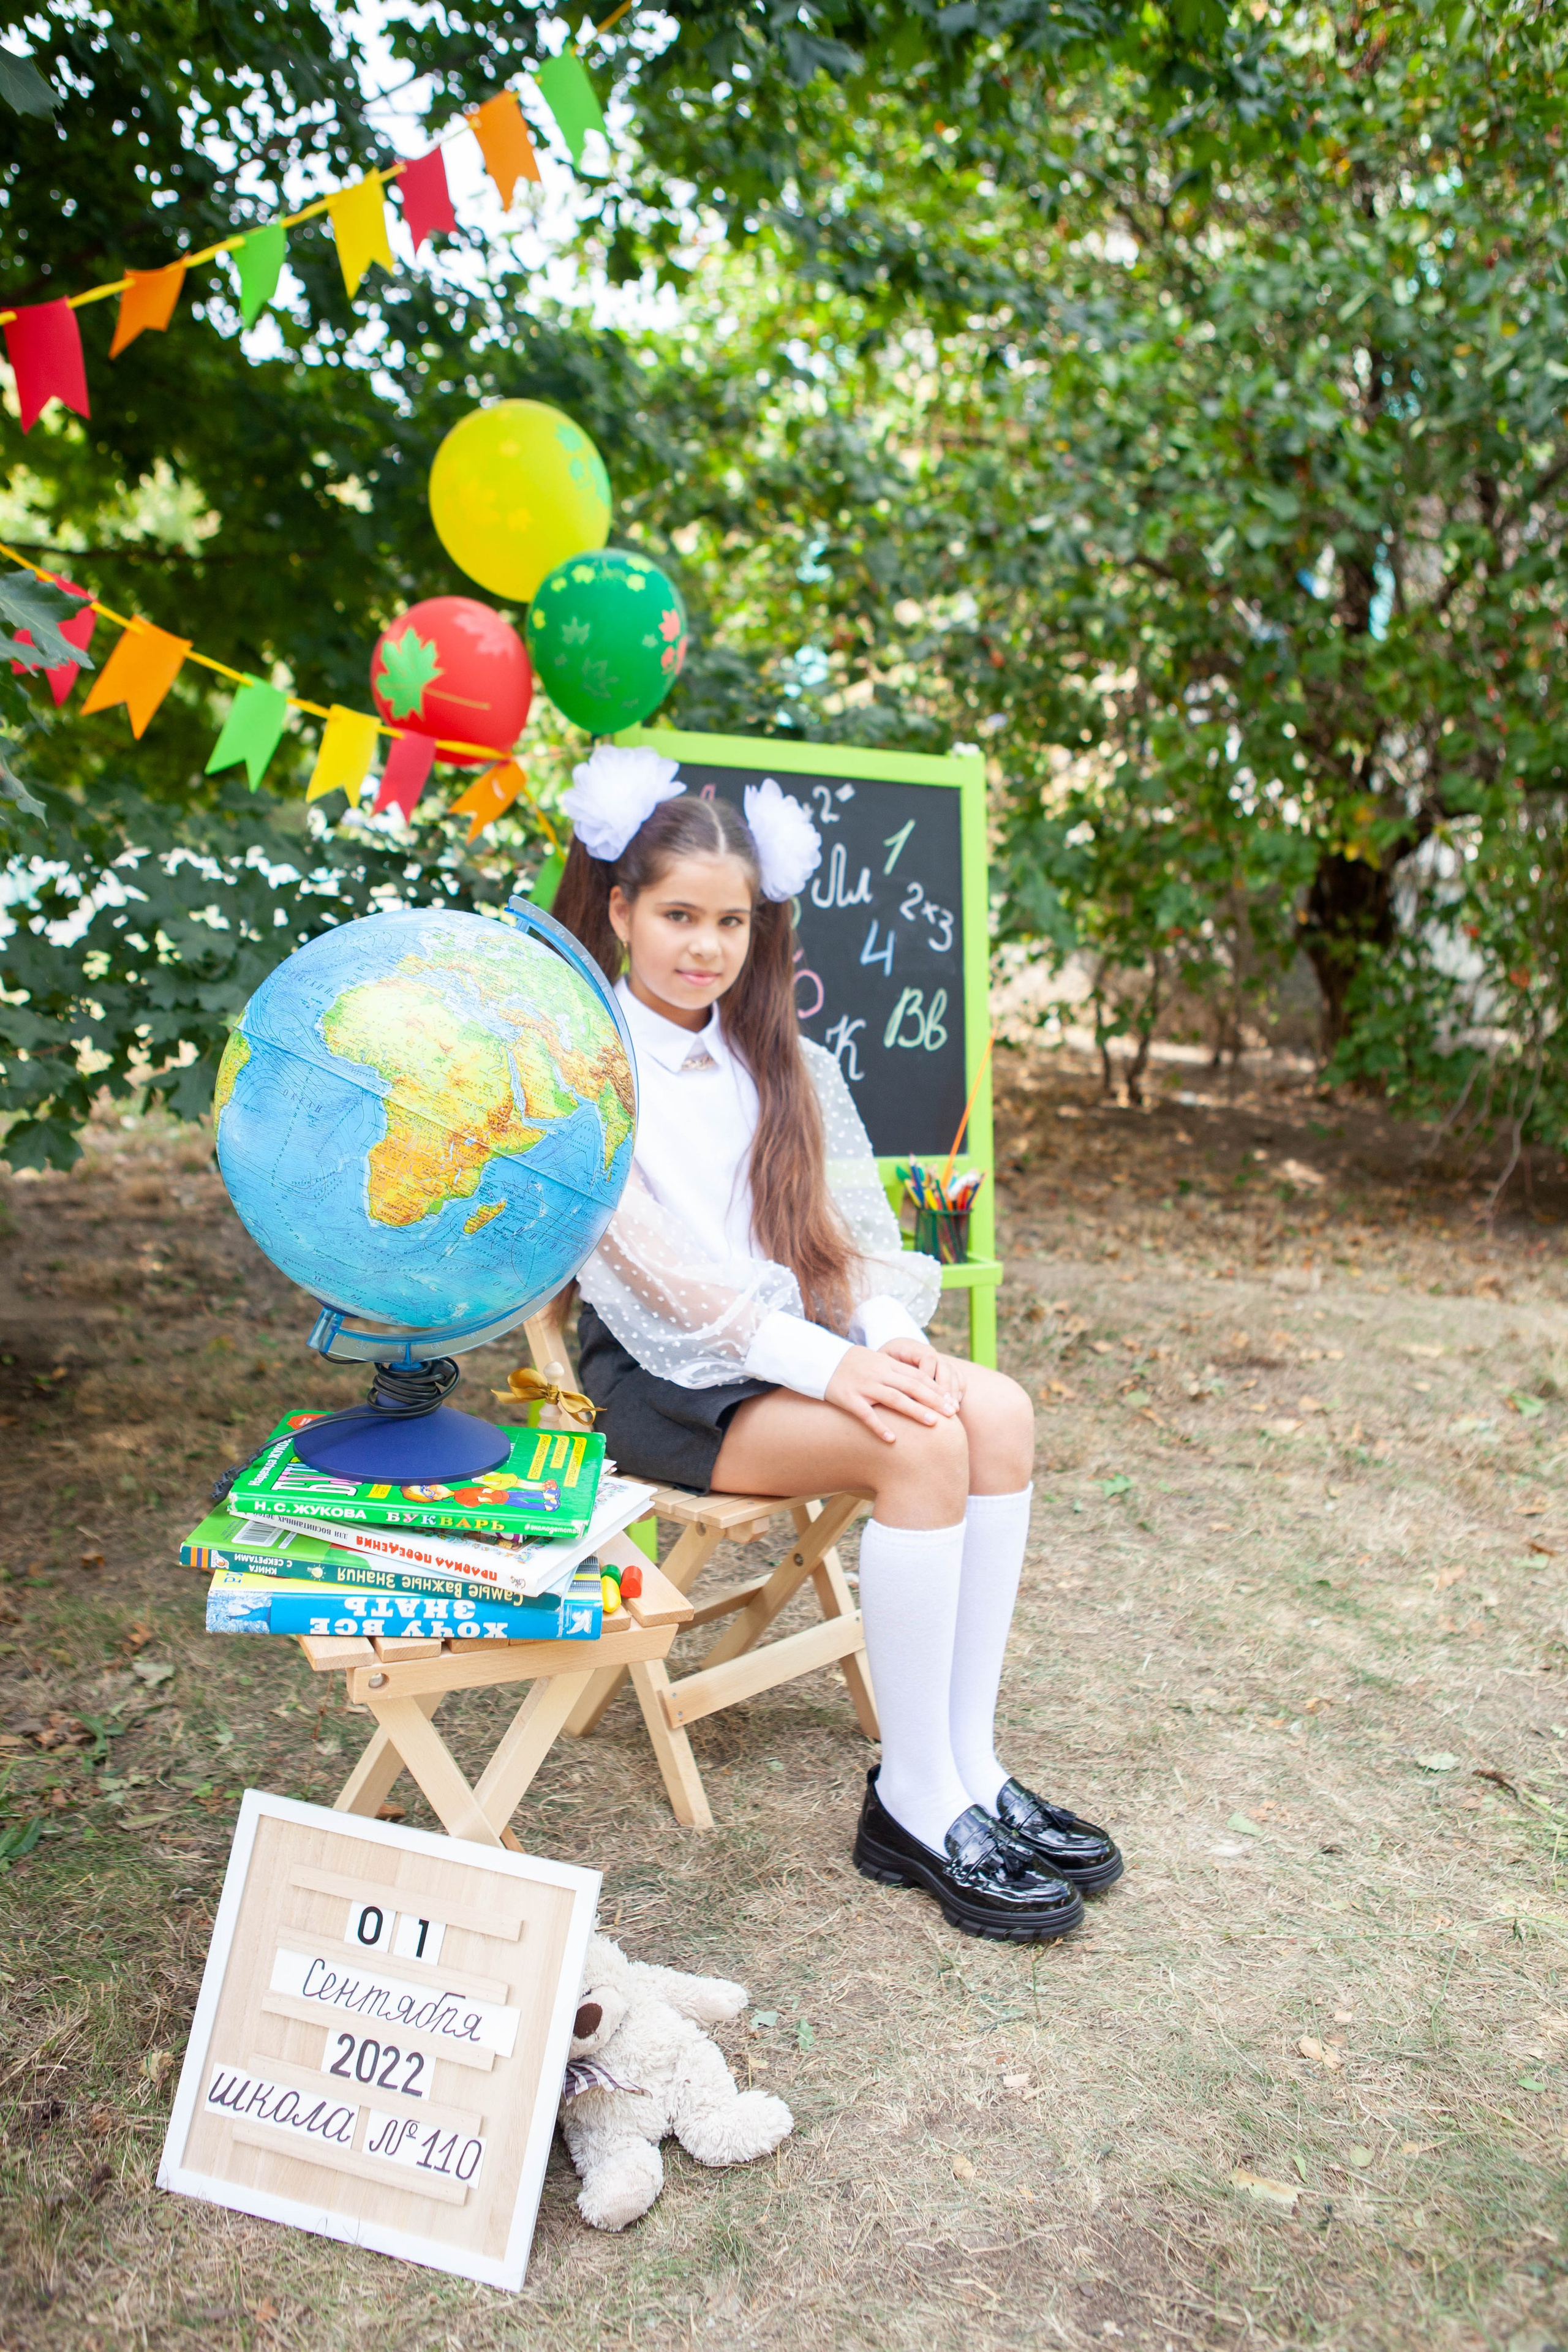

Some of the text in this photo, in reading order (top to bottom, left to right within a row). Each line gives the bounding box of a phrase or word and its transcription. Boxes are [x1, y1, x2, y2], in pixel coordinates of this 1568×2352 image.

[860, 919, 895, 977] 4
[247, 1437, 293, 1487] Надежда ЖУКОВ
[292, 1503, 368, 1520] ЖУКОВА
[386, 1511, 505, 1531] БУКВАРЬ
[277, 1516, 331, 1536] воспитанных
[234, 1553, 284, 1567] СЕКРЕТАМИ
[355, 1535, 432, 1564] ПОВЕДЕНИЯ
[249, 1564, 277, 1575] КНИГА
[435, 1556, 498, 1582] ПРАВИЛА
[337, 1567, 524, 1607] Самые Важные Знания
[344, 1596, 476, 1620] ЗНАТЬ
[310, 1618, 508, 1638] ХОЧУ ВСЕ
[301, 1958, 482, 2041] Сентября
[329, 2032, 424, 2098] 2022
